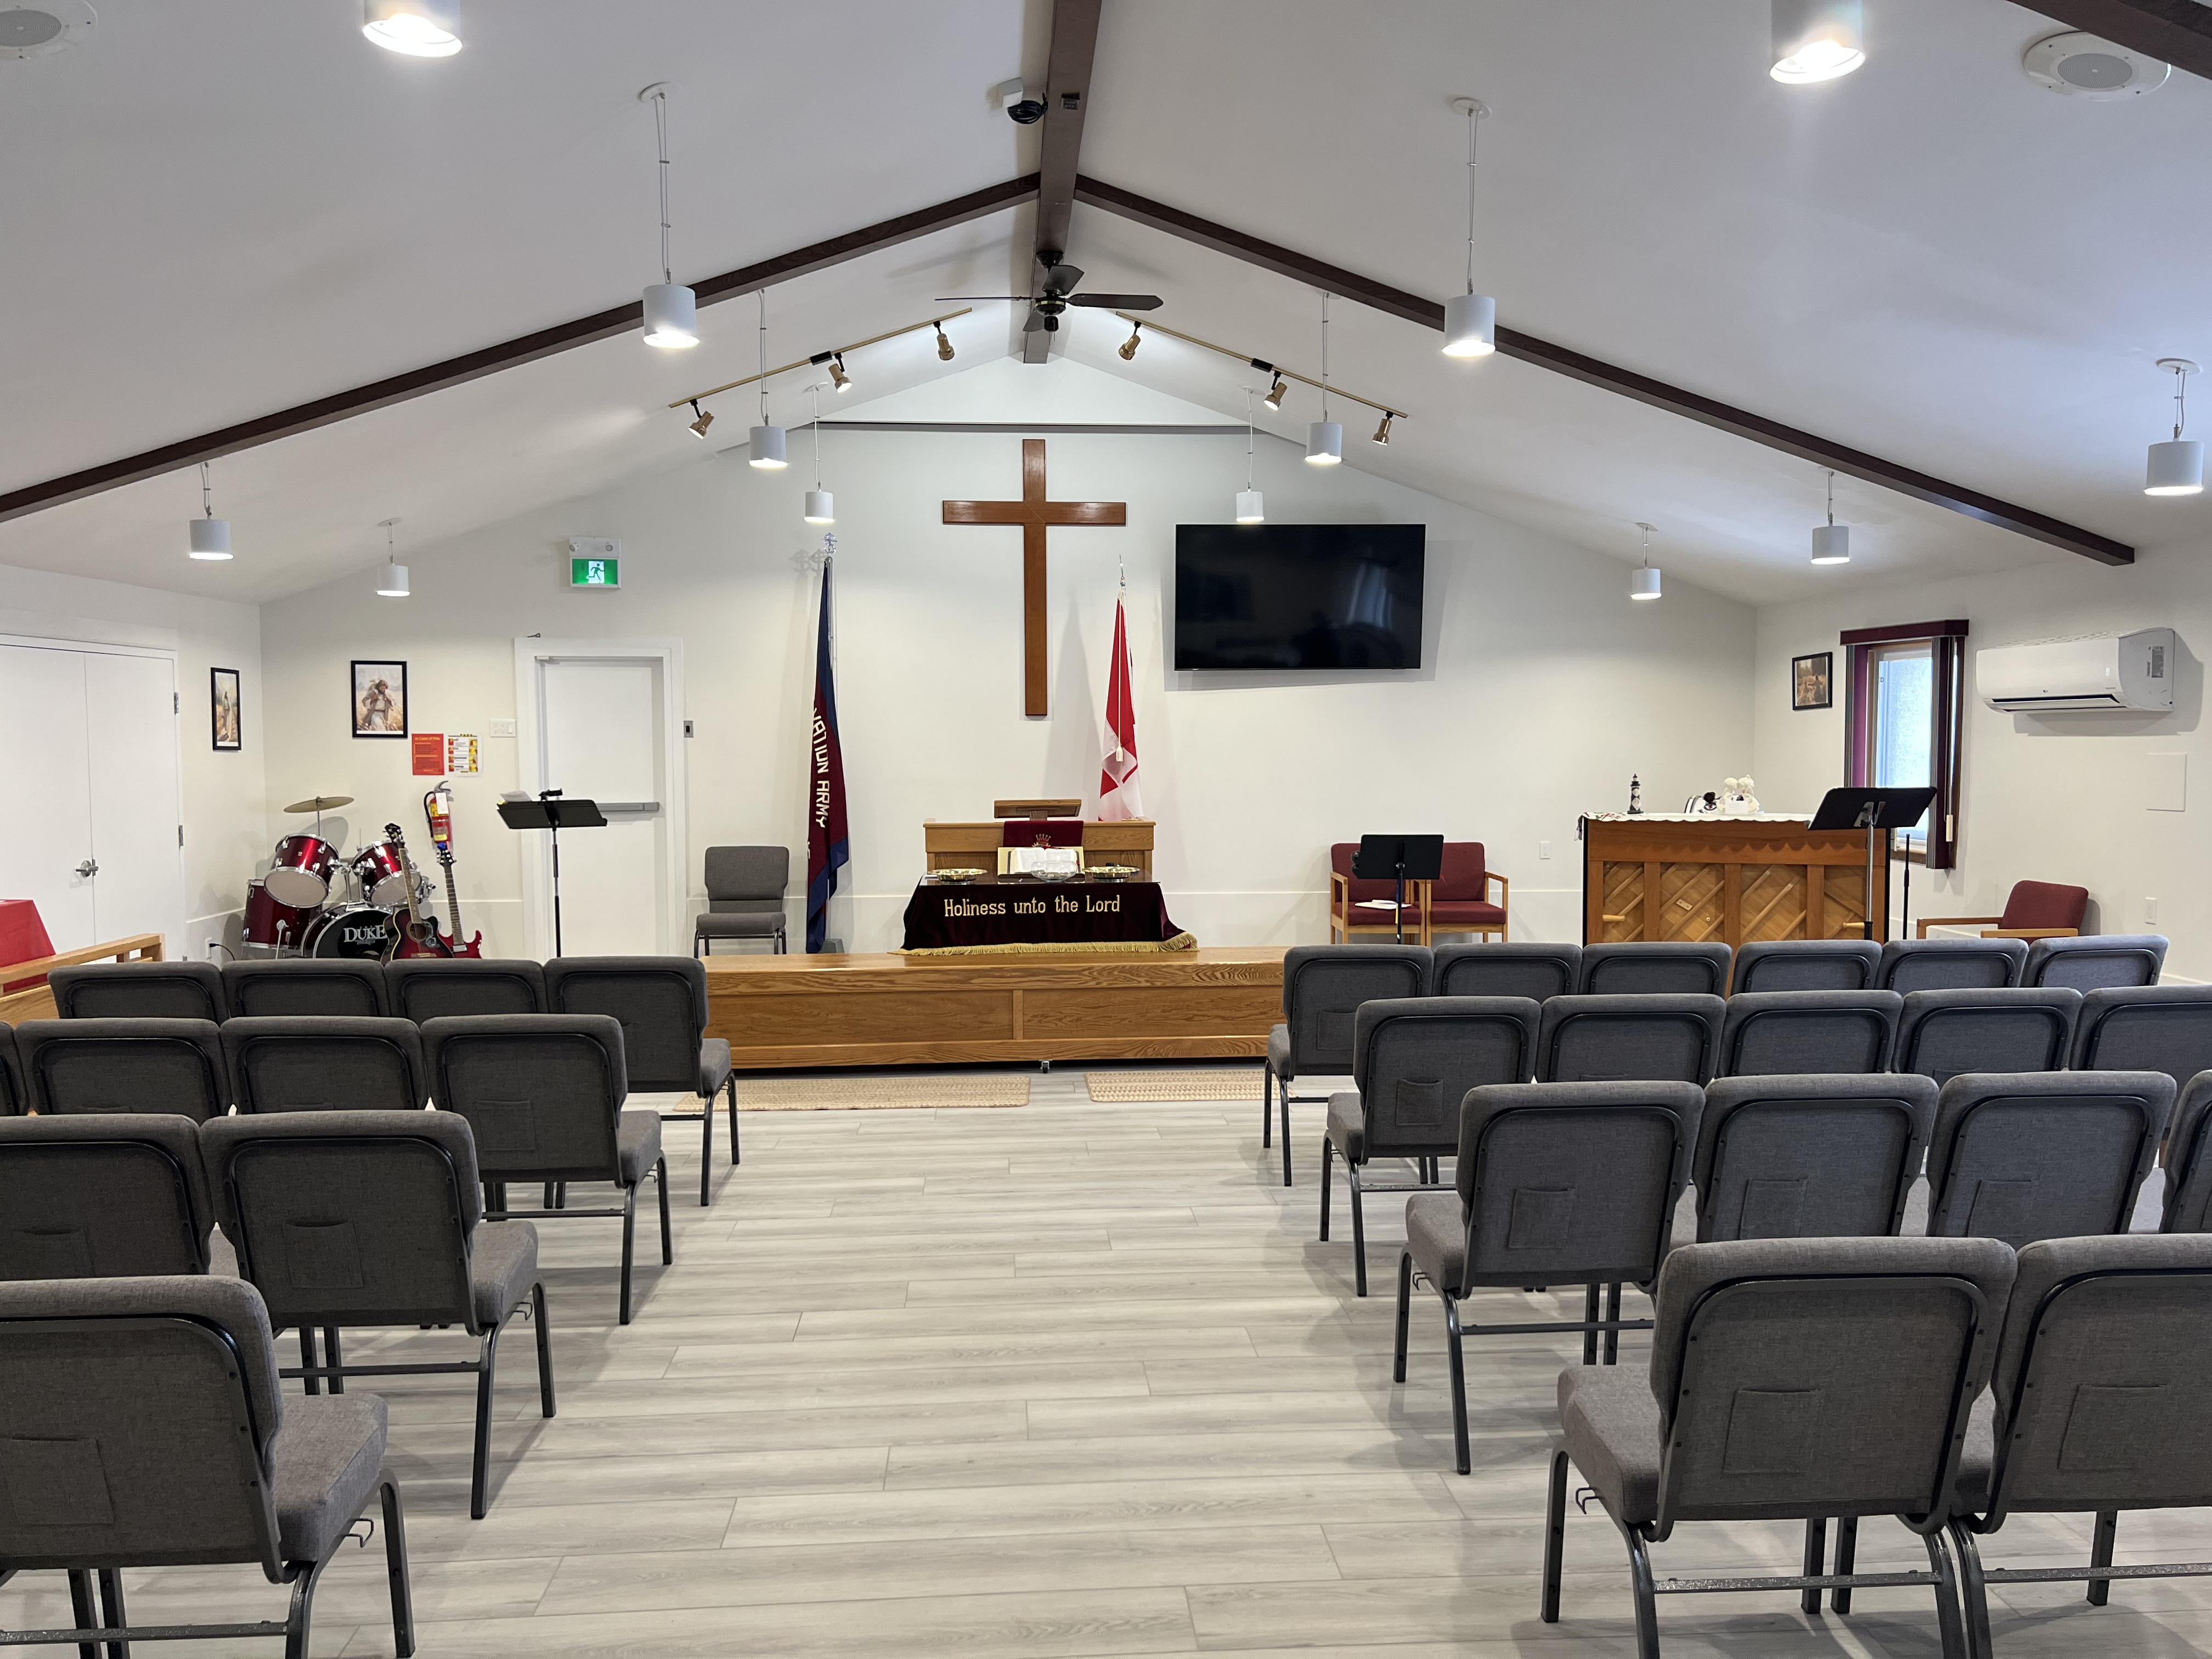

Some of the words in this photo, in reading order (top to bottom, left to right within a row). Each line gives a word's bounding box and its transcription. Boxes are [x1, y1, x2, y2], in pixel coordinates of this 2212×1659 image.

[815, 780, 830, 828] ARMY
[944, 898, 1006, 917] Holiness
[1014, 897, 1046, 914] unto
[1054, 895, 1079, 913] the
[1086, 895, 1120, 912] Lord
[343, 924, 388, 943] DUKE
